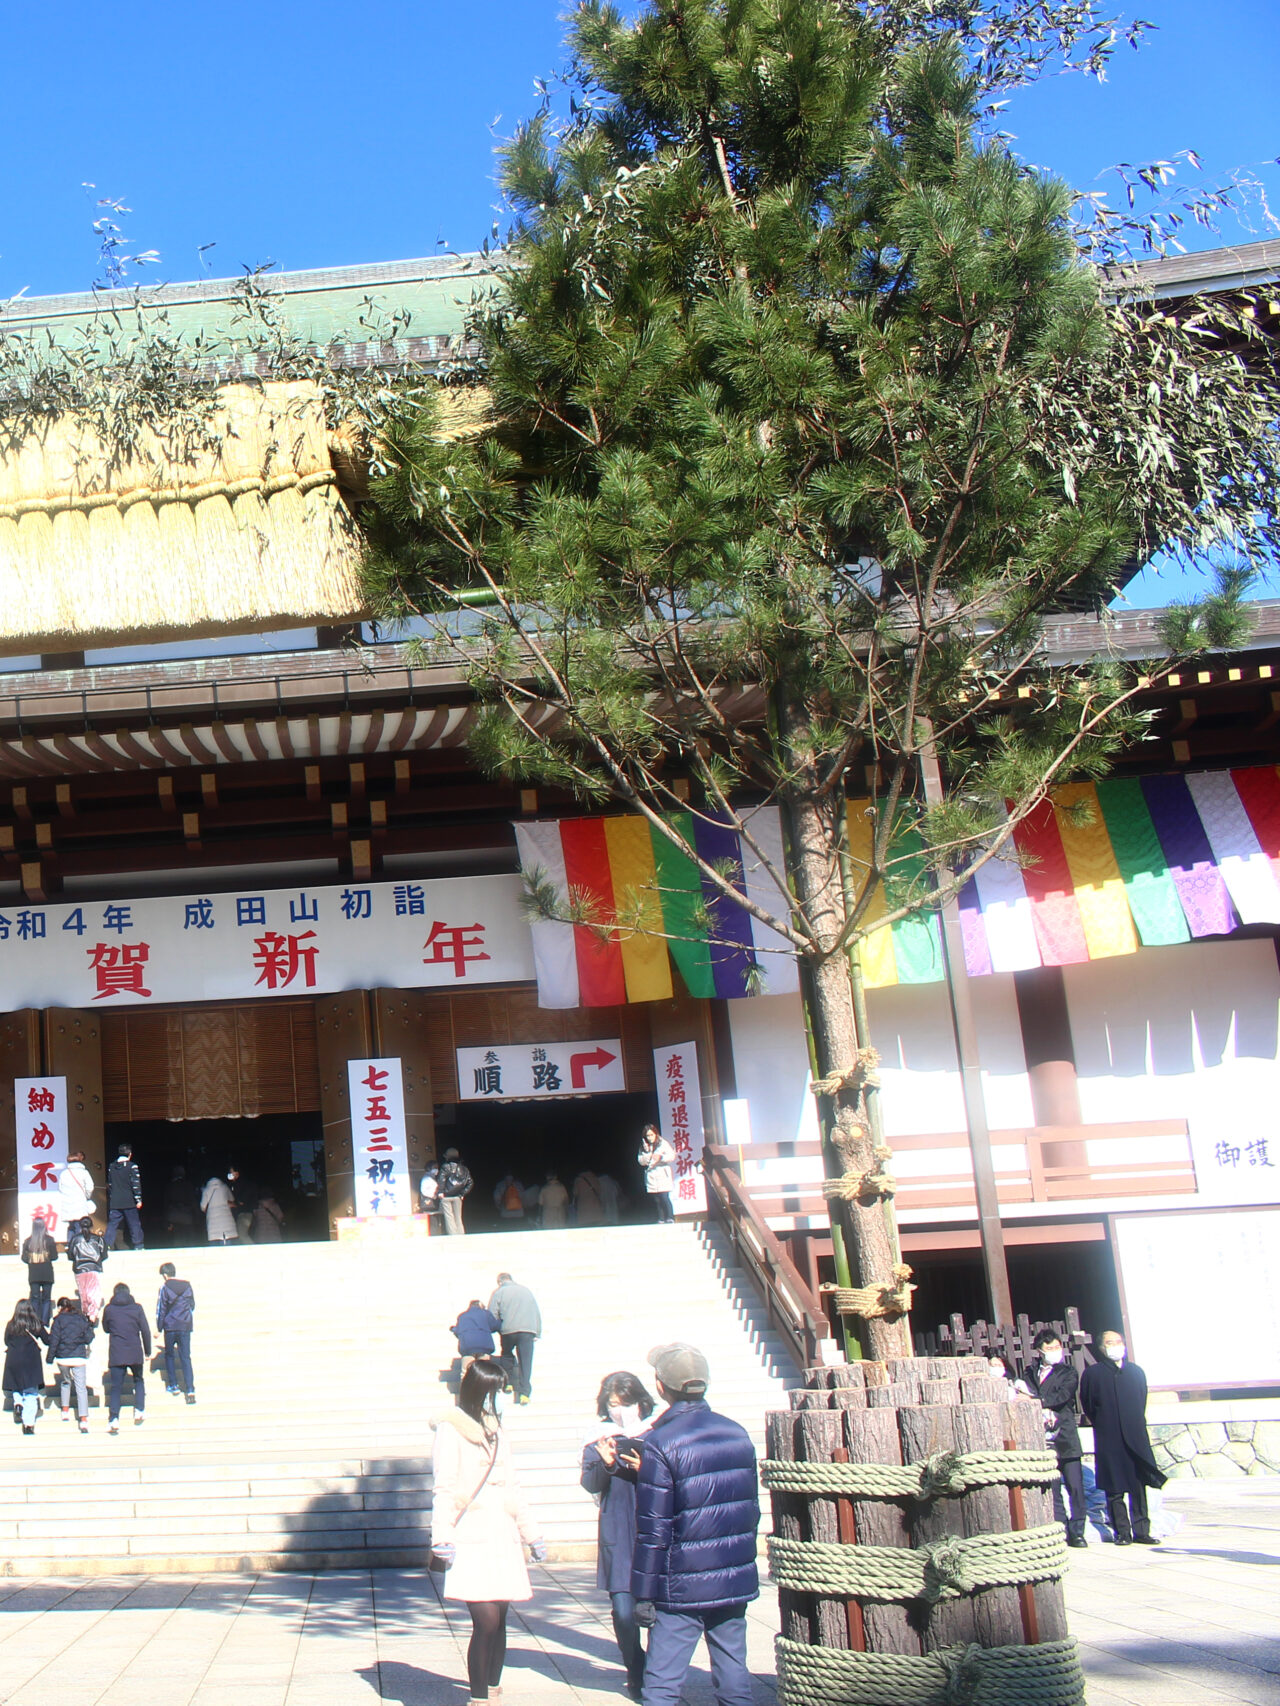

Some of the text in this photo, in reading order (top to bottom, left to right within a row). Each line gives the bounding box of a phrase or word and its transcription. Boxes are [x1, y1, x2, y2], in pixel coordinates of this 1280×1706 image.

[183, 885, 425, 929] 成田山初詣
[473, 1061, 562, 1095] 順路
[483, 1048, 547, 1064] 参詣
[665, 1054, 697, 1200] 疫病退散祈願
[28, 1087, 58, 1232] 納め不動
